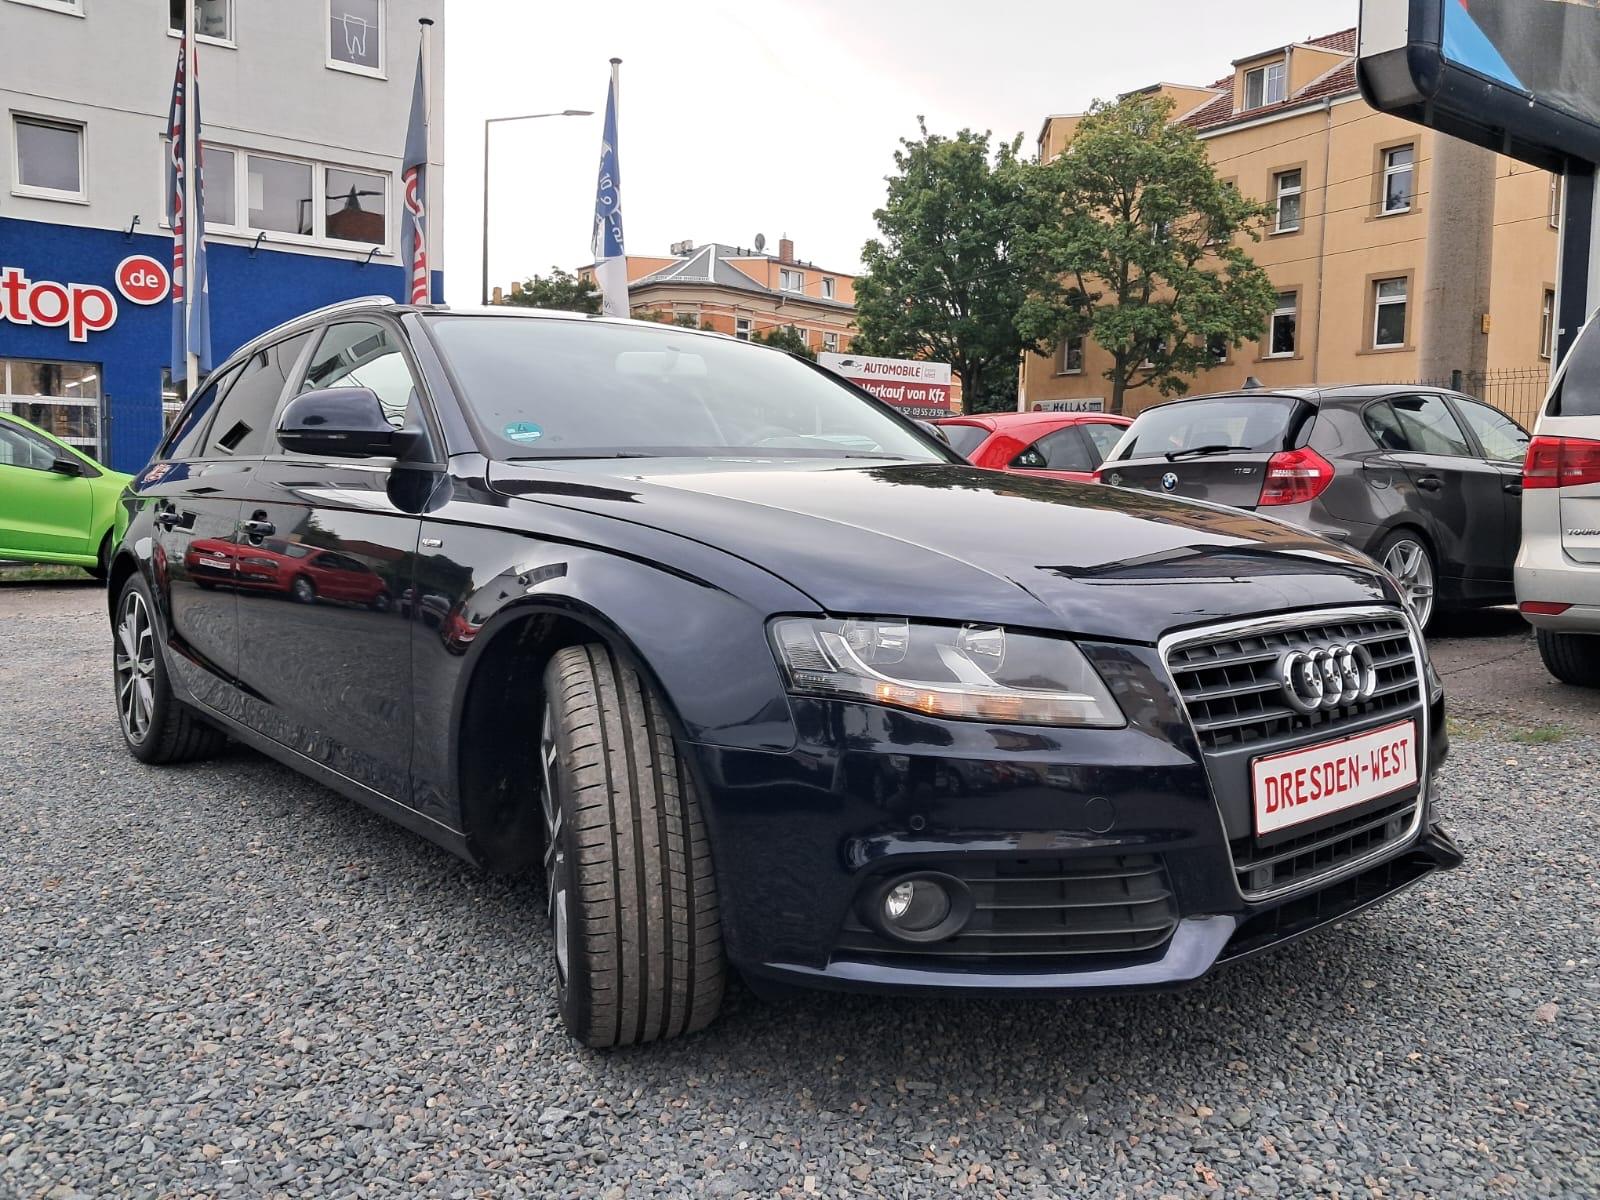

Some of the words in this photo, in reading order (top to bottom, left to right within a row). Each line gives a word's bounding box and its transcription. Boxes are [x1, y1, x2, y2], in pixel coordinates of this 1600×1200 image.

[0, 268, 117, 342] top
[125, 268, 160, 288] .de
[864, 363, 921, 377] AUTOMOBILE
[907, 389, 926, 401] von
[928, 389, 945, 403] Kfz
[1053, 401, 1087, 413] HELLAS
[1264, 738, 1409, 814] DRESDEN-WEST
